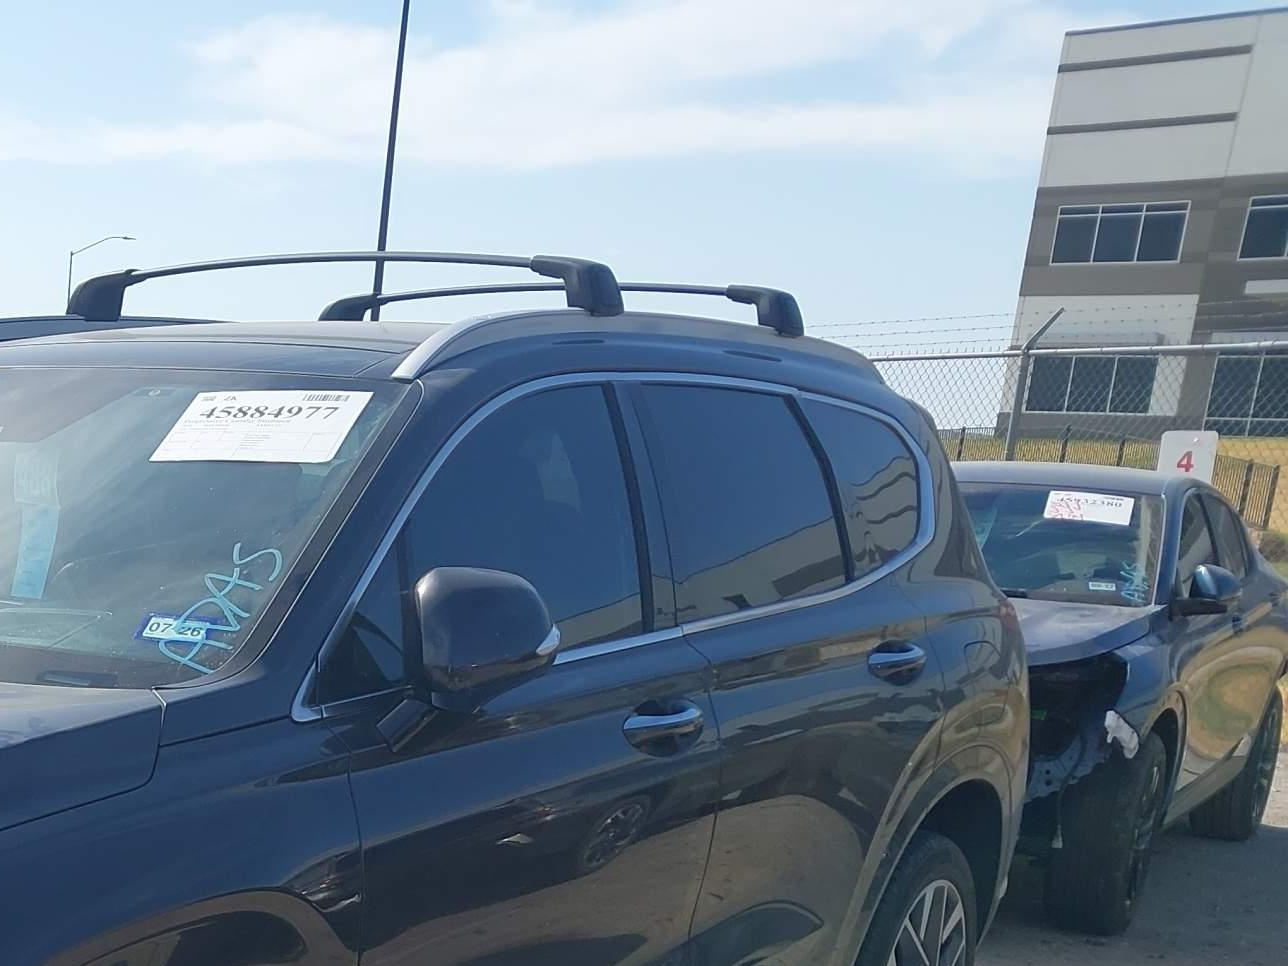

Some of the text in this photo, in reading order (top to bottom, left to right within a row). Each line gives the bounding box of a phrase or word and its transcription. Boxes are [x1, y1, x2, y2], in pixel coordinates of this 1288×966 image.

[199, 405, 340, 420] 45884977
[1176, 450, 1194, 473] 4
[158, 542, 283, 674] ADAS
